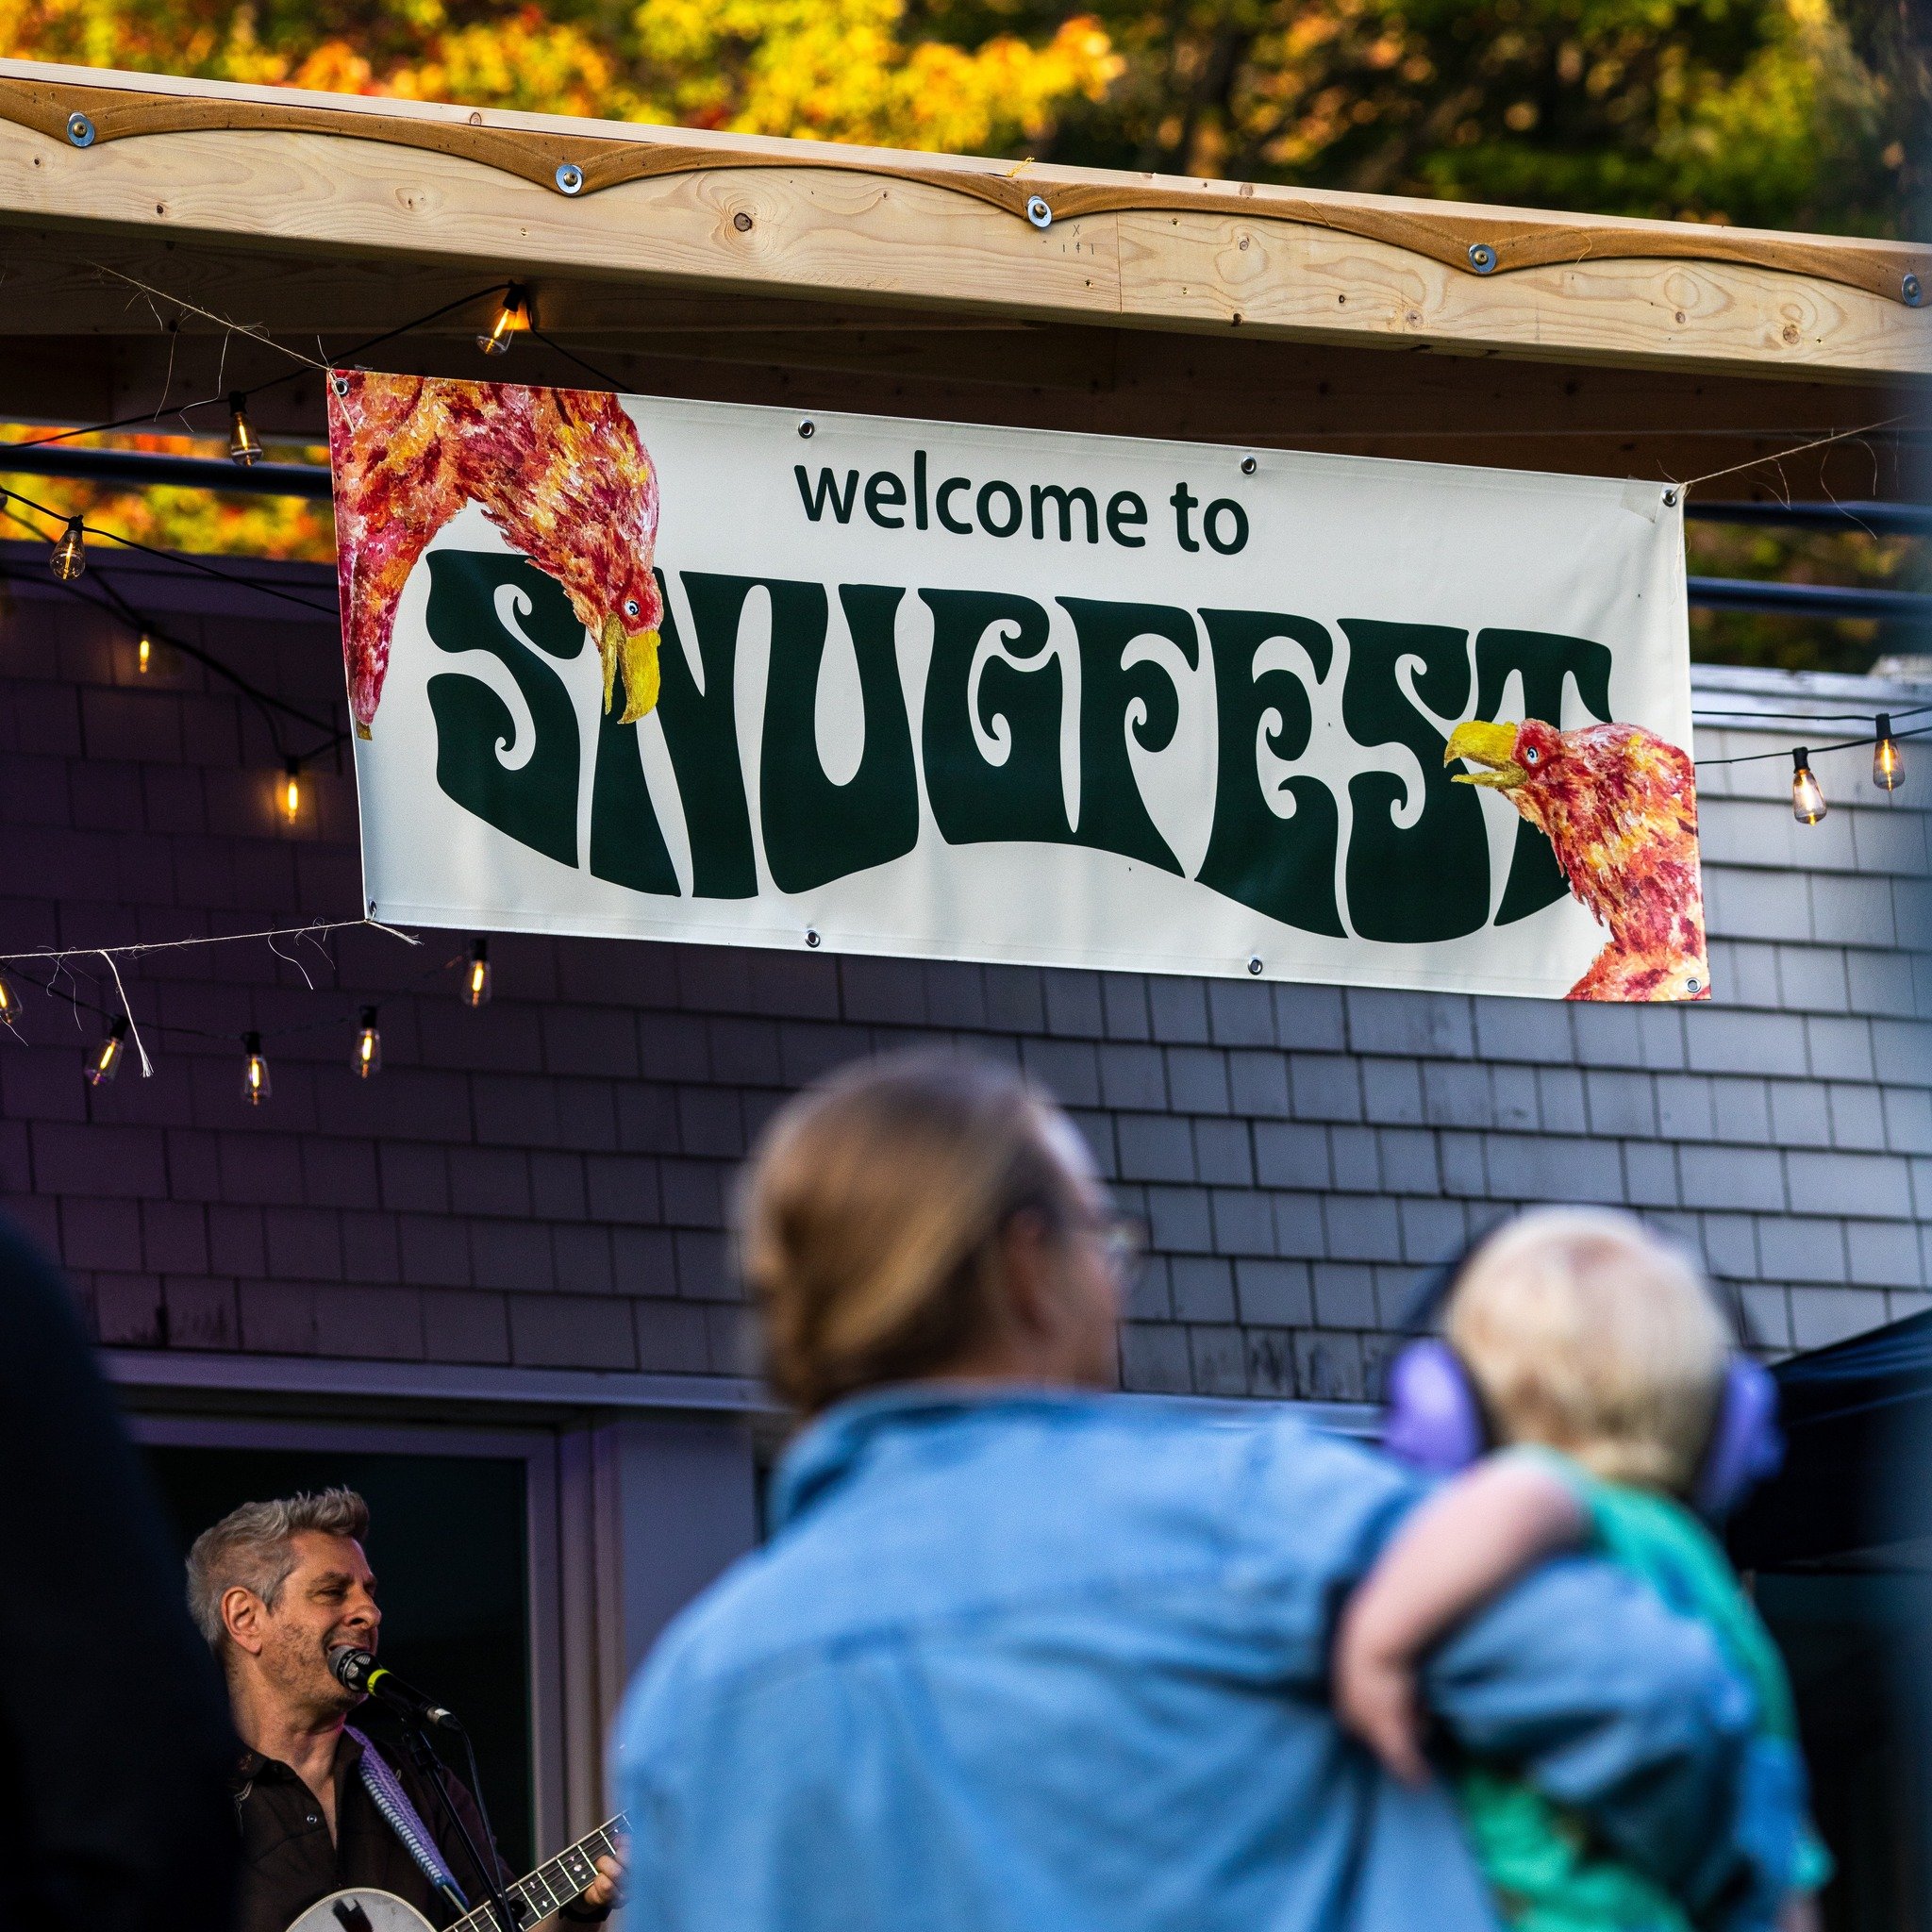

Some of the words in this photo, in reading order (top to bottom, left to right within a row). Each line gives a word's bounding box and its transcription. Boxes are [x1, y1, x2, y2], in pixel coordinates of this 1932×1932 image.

[793, 450, 1148, 549] welcome
[1170, 482, 1250, 556] to
[425, 548, 1613, 945] SNUGFEST
